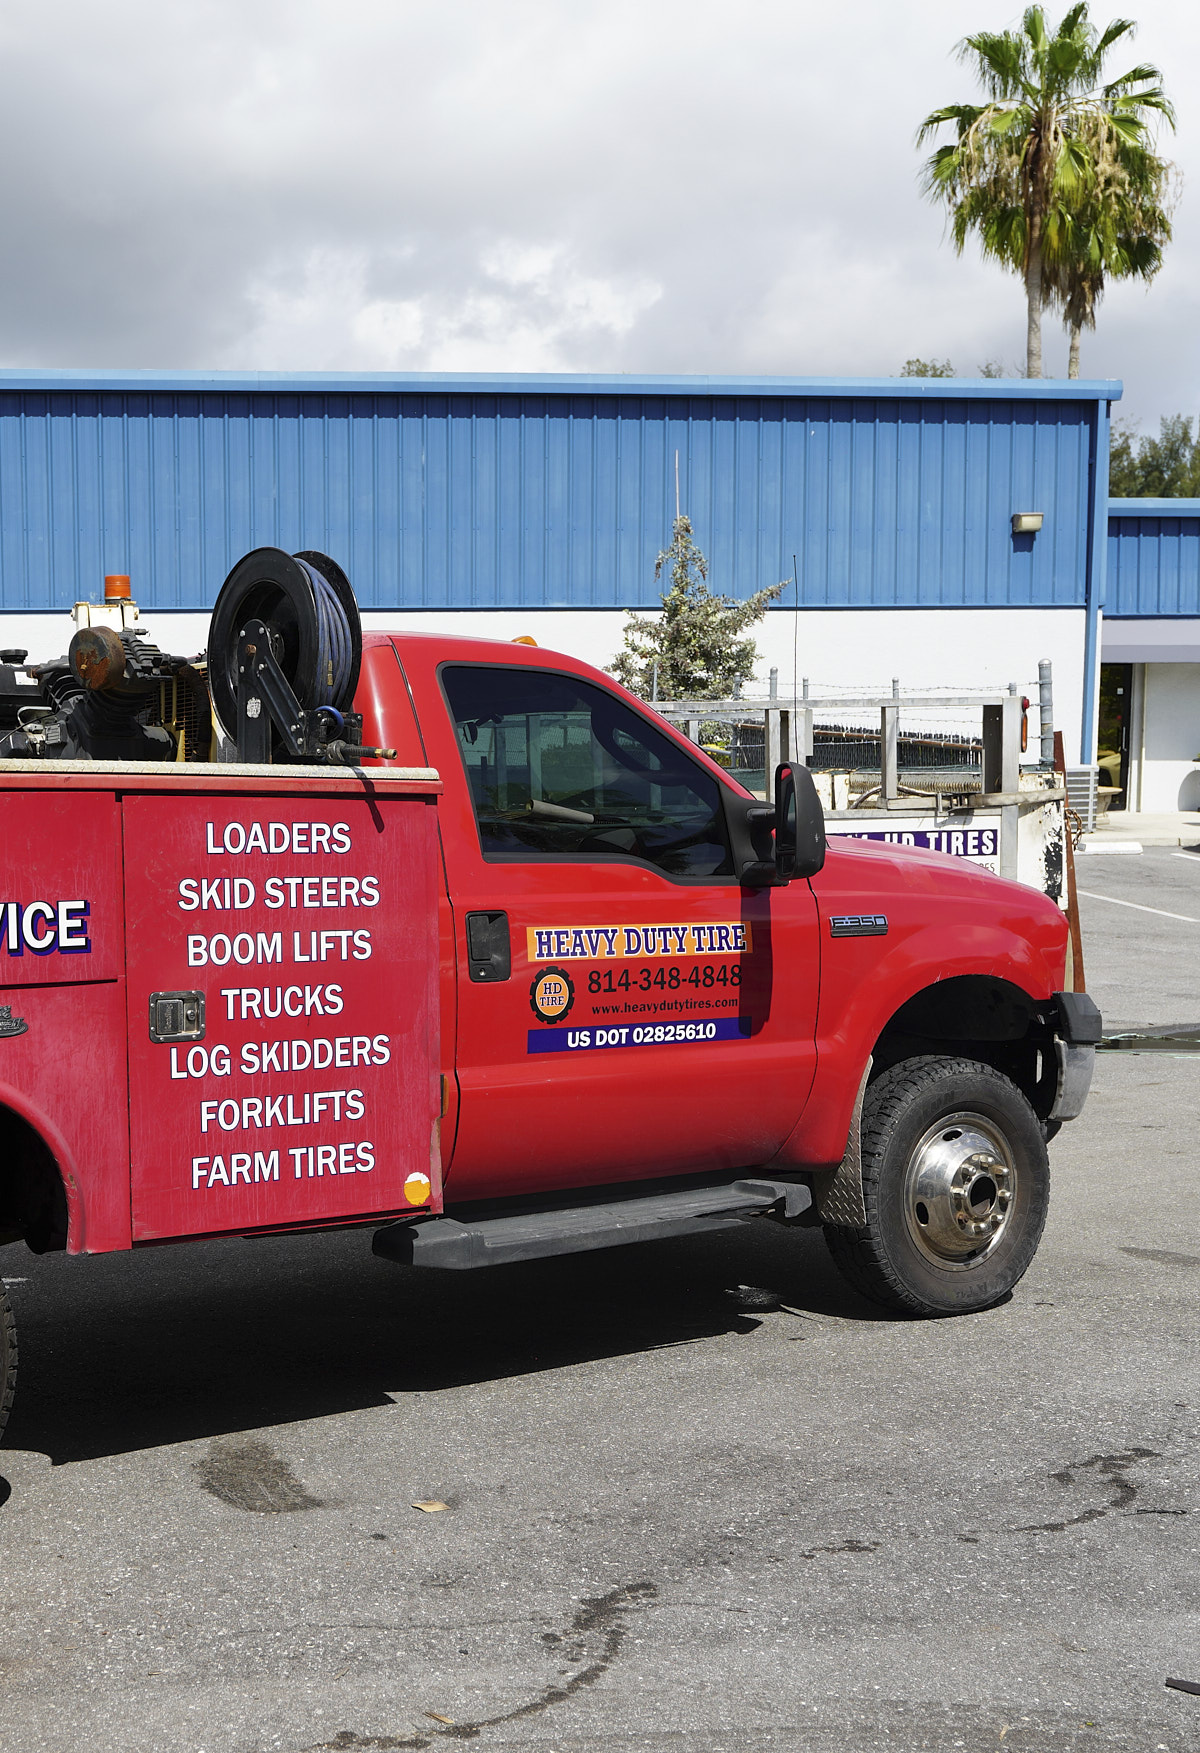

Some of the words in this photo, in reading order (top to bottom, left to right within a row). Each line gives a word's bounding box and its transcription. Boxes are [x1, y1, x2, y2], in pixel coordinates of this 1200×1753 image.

[206, 822, 352, 855] LOADERS
[927, 830, 996, 856] TIRES
[178, 877, 256, 911] SKID
[264, 876, 381, 909] STEERS
[187, 932, 282, 967] BOOM
[293, 929, 373, 963] LIFTS
[534, 927, 619, 960] HEAVY
[623, 925, 689, 956] DUTY
[691, 923, 748, 953] TIRE
[543, 981, 563, 996] HD
[587, 964, 742, 994] 814-348-4848
[220, 984, 344, 1020] TRUCKS
[539, 995, 565, 1007] TIRE
[591, 997, 738, 1016] www.heavydutytires.com
[567, 1030, 591, 1048] US
[595, 1028, 630, 1047] DOT
[632, 1022, 717, 1043] 02825610
[170, 1045, 232, 1080] LOG
[239, 1034, 391, 1075] SKIDDERS
[200, 1089, 365, 1133] FORKLIFTS
[192, 1149, 281, 1190] FARM
[288, 1141, 376, 1180] TIRES
